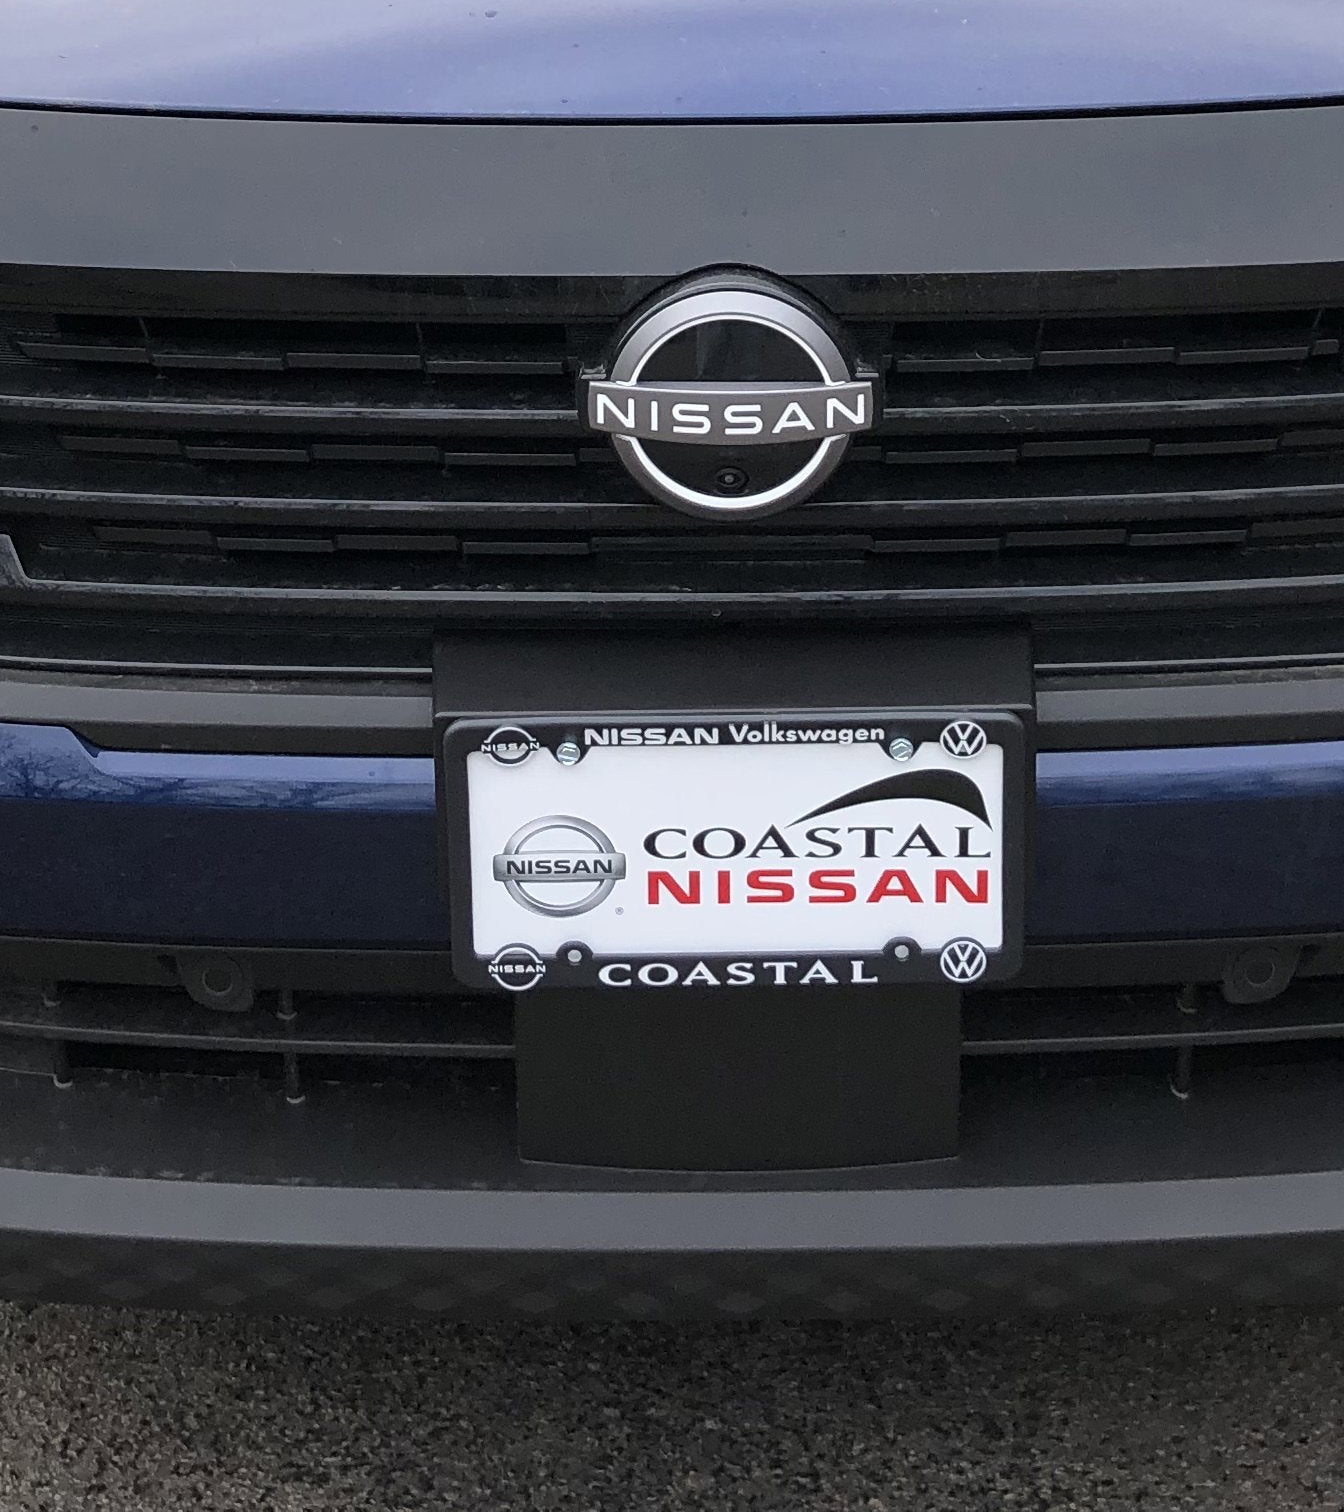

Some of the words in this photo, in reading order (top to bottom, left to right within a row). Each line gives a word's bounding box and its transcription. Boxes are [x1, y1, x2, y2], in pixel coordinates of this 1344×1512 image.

[596, 393, 865, 435] NISSAN
[584, 727, 719, 745] NISSAN
[729, 721, 885, 744] Volkswagen
[481, 742, 540, 753] NISSAN
[643, 823, 992, 860] COASTAL
[506, 859, 613, 875] NISSAN
[647, 869, 989, 904] NISSAN
[488, 963, 546, 974] NISSAN
[598, 960, 878, 986] COASTAL
